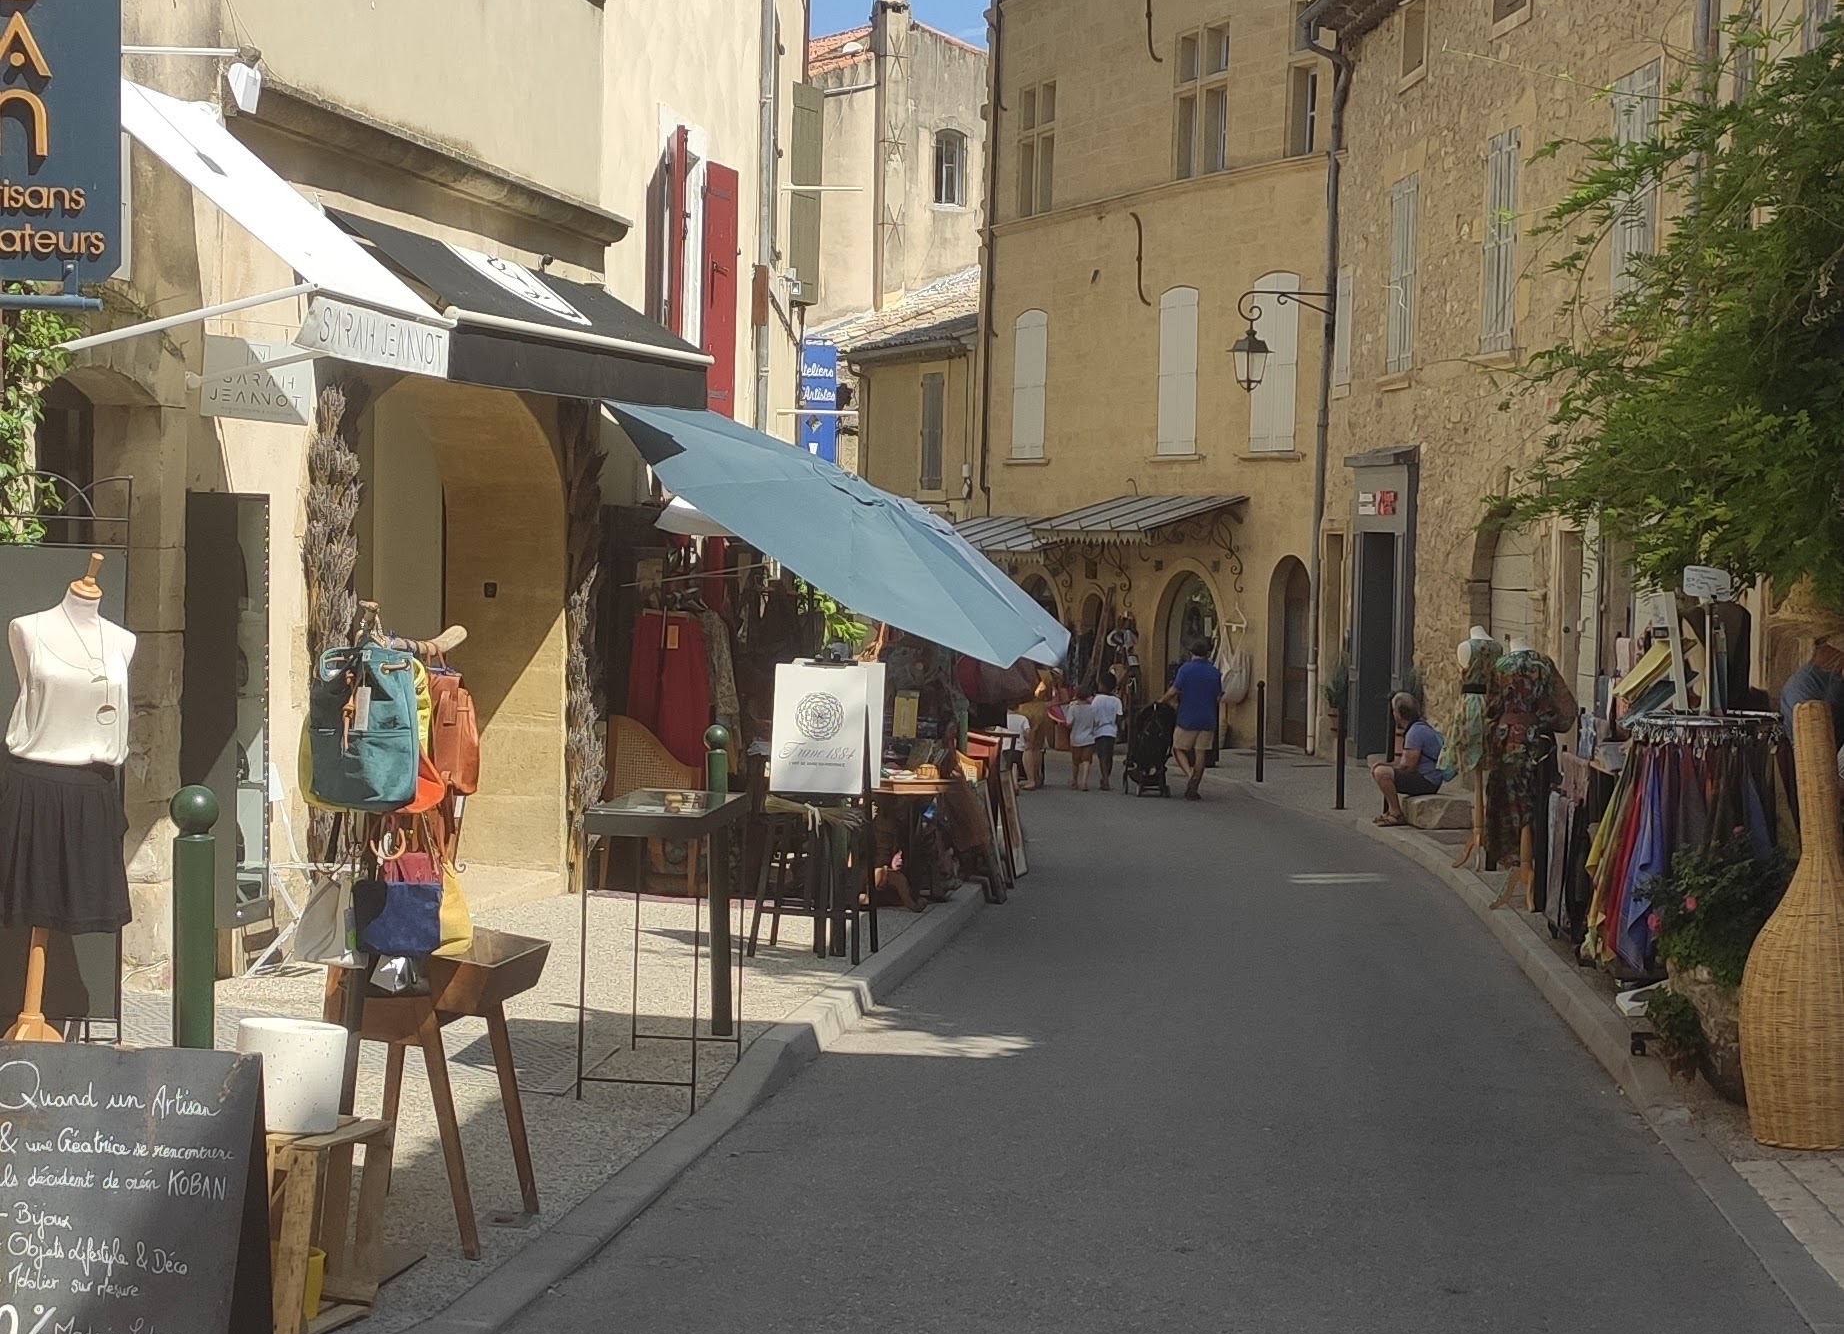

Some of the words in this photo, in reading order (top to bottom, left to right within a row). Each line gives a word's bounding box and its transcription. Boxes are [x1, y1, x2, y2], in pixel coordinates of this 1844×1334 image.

[320, 307, 376, 353] SARAH
[210, 388, 303, 409] JEANNOT
[0, 1060, 98, 1110] Quand
[106, 1093, 147, 1110] un
[151, 1084, 221, 1120] Artisan
[0, 1121, 19, 1155] &
[25, 1140, 53, 1153] une
[28, 1165, 95, 1188] décident
[103, 1169, 120, 1190] de
[168, 1167, 227, 1201] KOBAN
[14, 1201, 72, 1240] Bijoux
[8, 1232, 64, 1269] Objets
[136, 1240, 148, 1271] &
[151, 1248, 188, 1276] Déco
